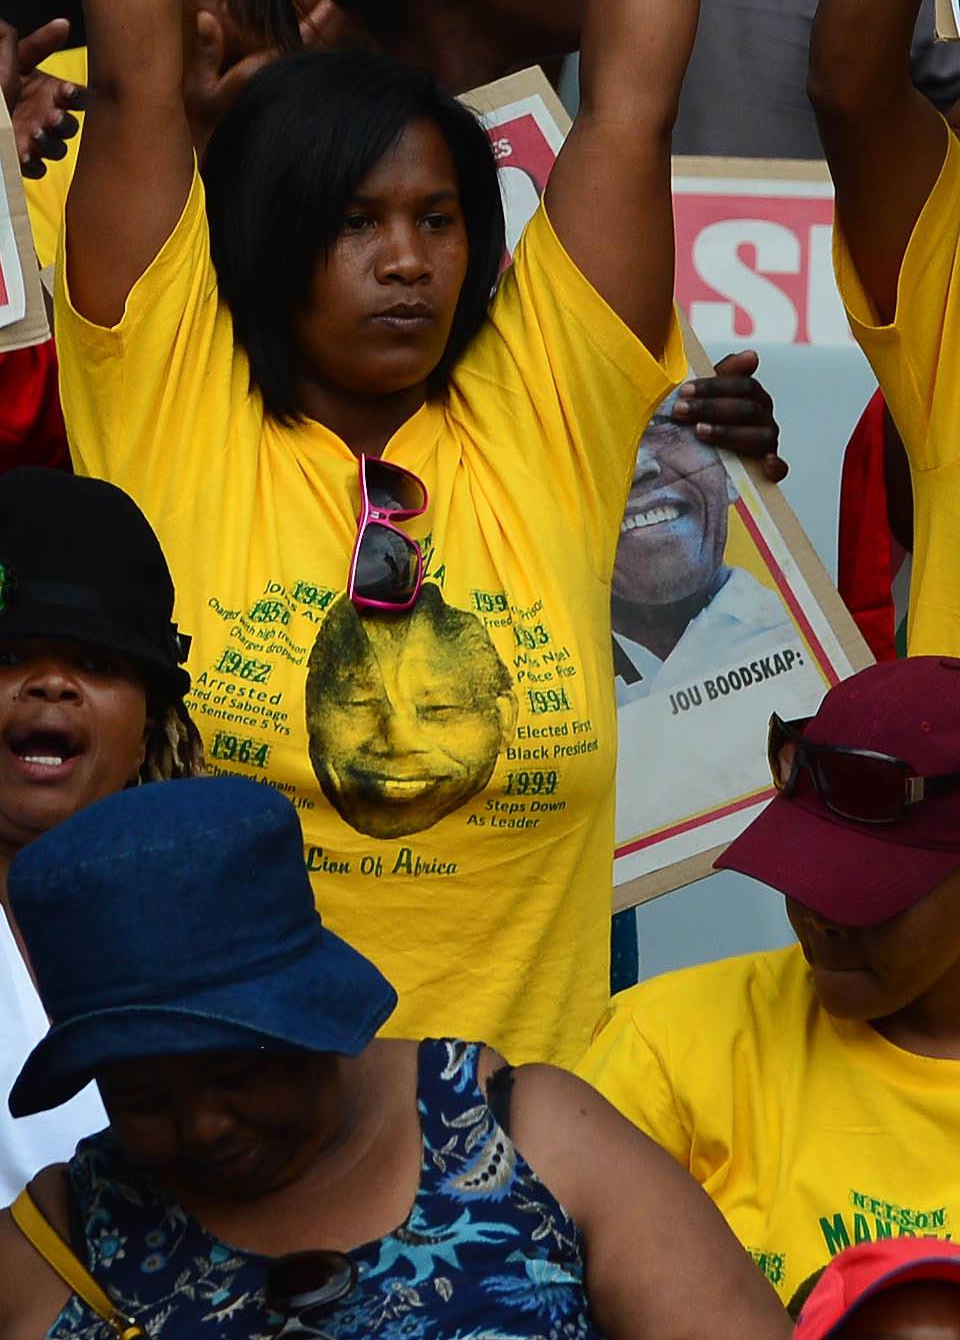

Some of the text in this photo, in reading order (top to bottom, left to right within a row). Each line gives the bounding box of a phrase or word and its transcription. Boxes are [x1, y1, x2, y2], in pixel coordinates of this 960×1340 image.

[214, 648, 273, 684] 1962
[196, 671, 284, 706] Arrested
[668, 648, 804, 716] JOU BOODSKAP:
[200, 703, 257, 727] Sentence
[260, 719, 269, 730] 5
[273, 722, 291, 737] Yrs
[213, 694, 227, 706] of
[229, 696, 289, 722] Sabotage
[517, 720, 592, 739] Elected First
[210, 732, 270, 768] 1964
[506, 739, 599, 760] Black President
[504, 770, 557, 795] 1999
[466, 814, 540, 829] As Leader
[485, 798, 566, 814] Steps Down
[360, 856, 383, 878] Of
[391, 847, 459, 877] Africa
[850, 1189, 946, 1229] NELSON
